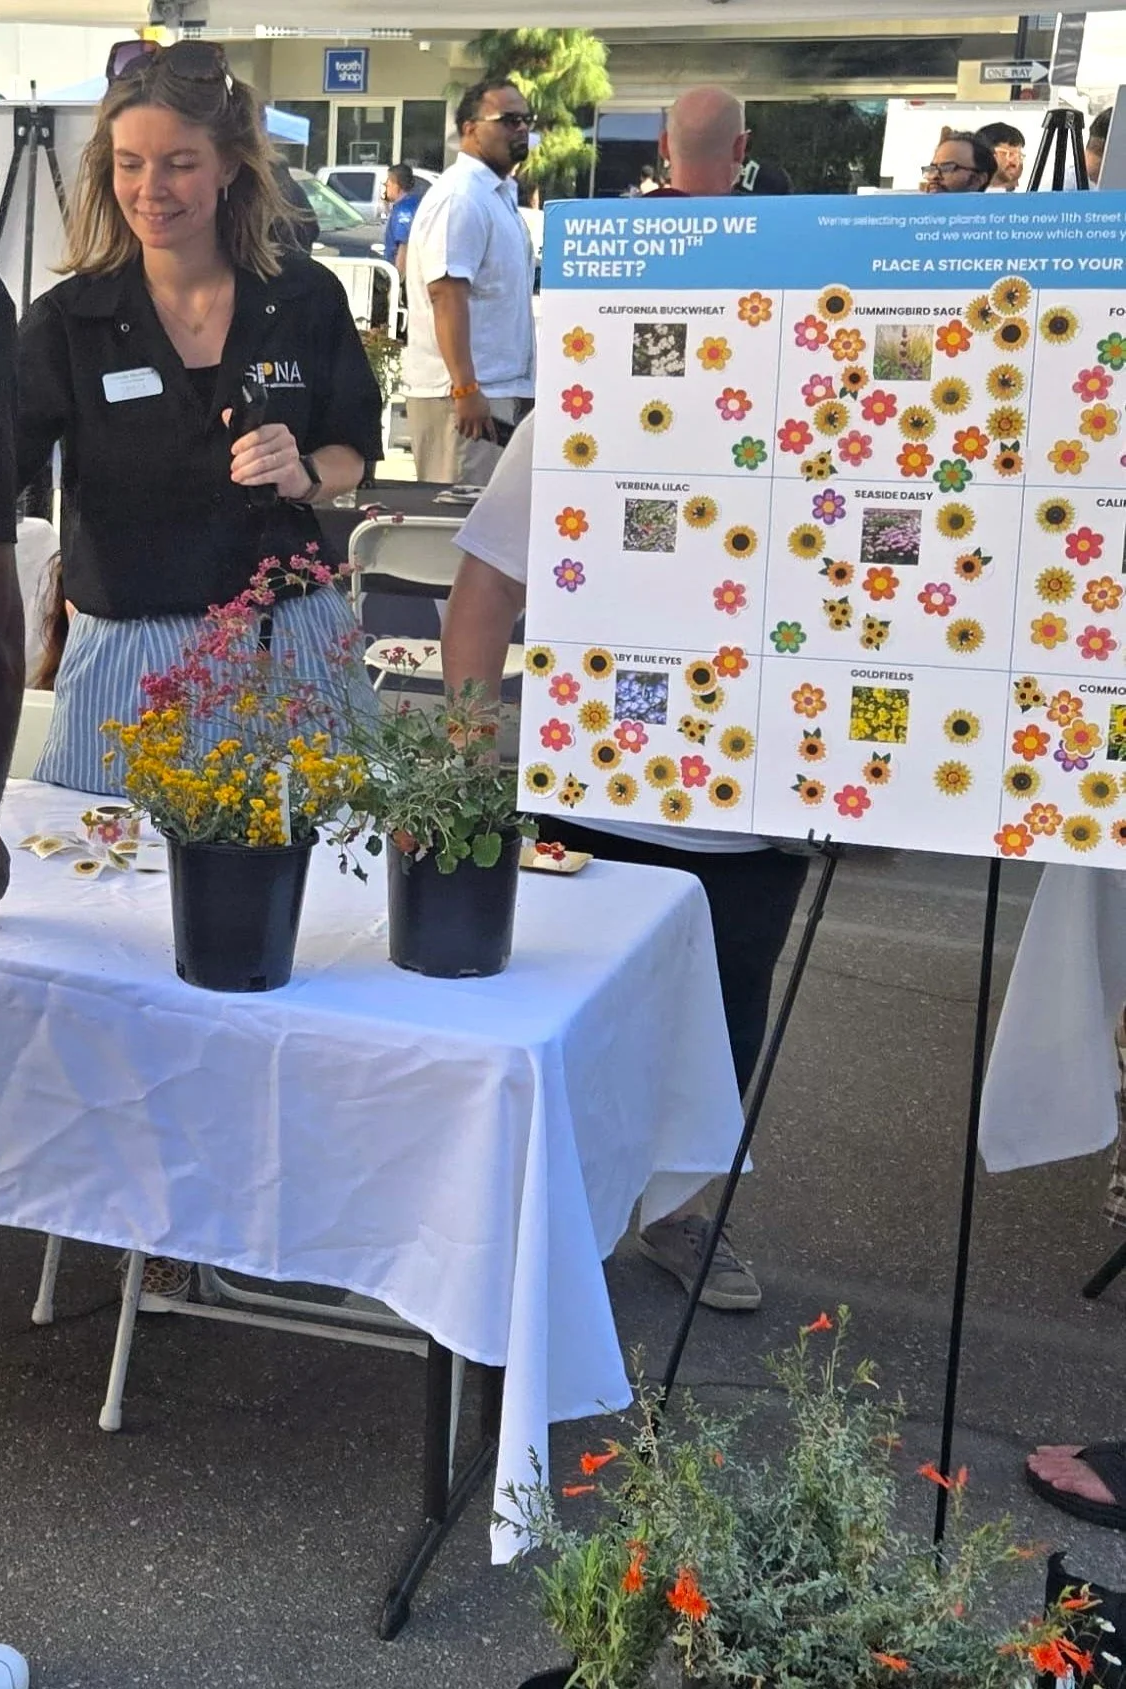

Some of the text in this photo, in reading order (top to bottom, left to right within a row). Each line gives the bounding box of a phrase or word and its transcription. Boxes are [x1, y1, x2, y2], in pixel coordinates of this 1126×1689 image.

[335, 60, 361, 71] tooth
[338, 71, 361, 83] shop
[987, 67, 1031, 78] ONE WAY
[853, 214, 907, 228] selecting
[909, 214, 947, 225] native
[949, 213, 987, 227] plants
[989, 213, 1006, 224] for
[1009, 213, 1029, 224] the
[1032, 213, 1059, 223] new
[1061, 212, 1082, 223] 11th
[1085, 211, 1121, 223] Street
[564, 216, 758, 236] WHAT SHOULD WE
[915, 230, 940, 241] and
[942, 231, 960, 240] we
[962, 230, 993, 240] want
[996, 230, 1009, 240] to
[1011, 229, 1044, 240] know
[1046, 228, 1083, 239] which
[1086, 230, 1116, 239] ones
[563, 239, 629, 257] PLANT
[633, 239, 665, 256] ON
[562, 260, 647, 277] STREET?
[872, 257, 1124, 272] PLACE A STICKER NEXT TO YOUR
[598, 305, 726, 315] CALIFORNIA BUCKWHEAT
[933, 307, 963, 316] SAGE
[615, 481, 691, 492] VERBENA LILAC
[854, 490, 934, 501] SEASIDE DAISY
[633, 654, 657, 664] BLUE
[658, 656, 682, 666] EYES
[850, 669, 914, 681] GOLDFIELDS
